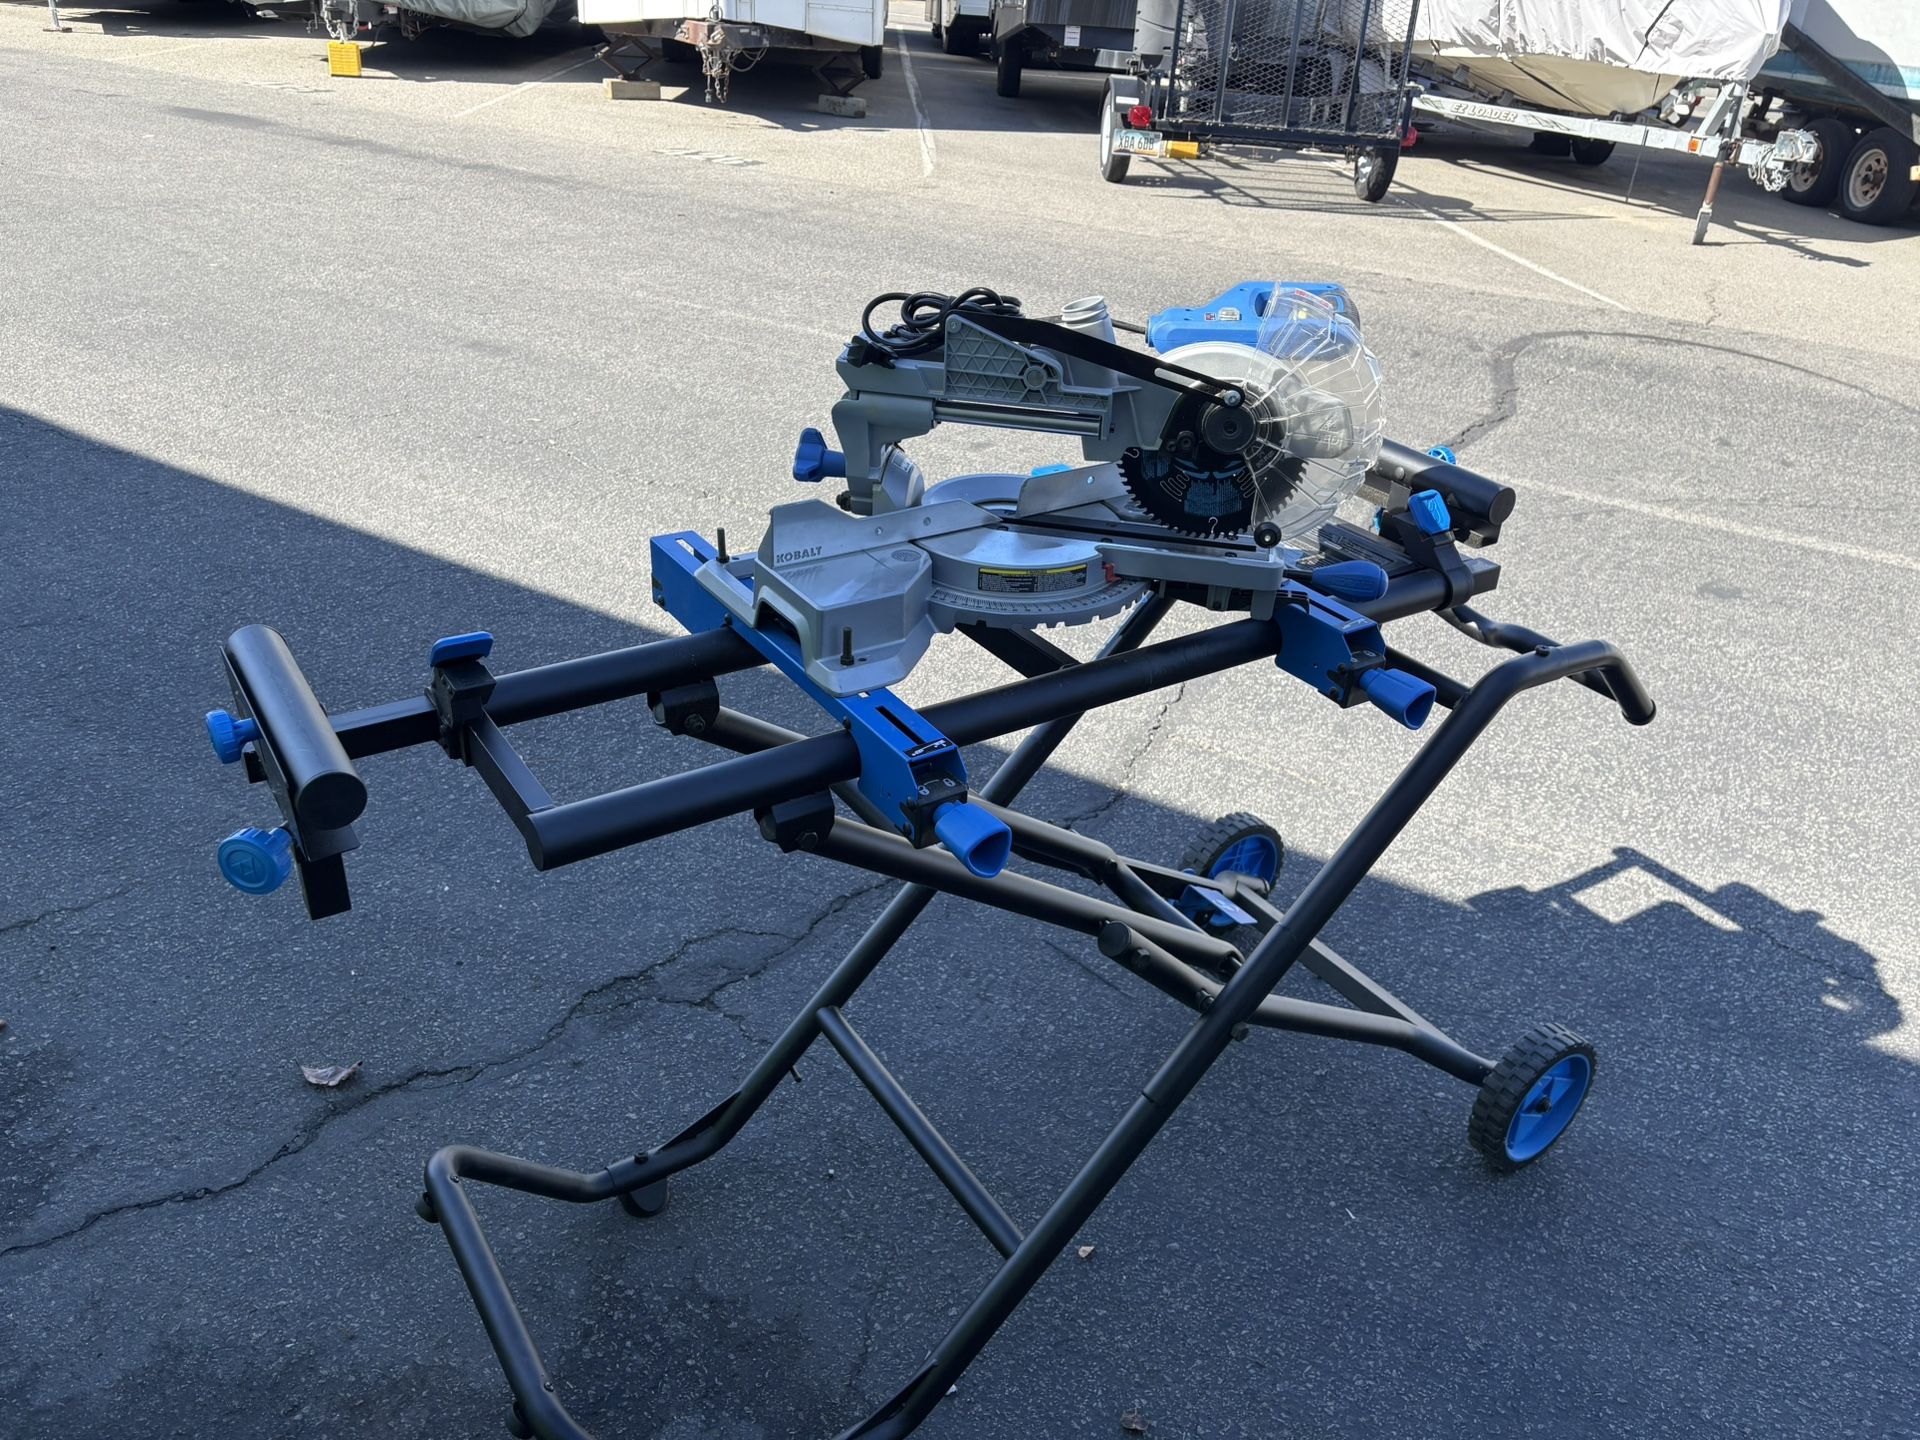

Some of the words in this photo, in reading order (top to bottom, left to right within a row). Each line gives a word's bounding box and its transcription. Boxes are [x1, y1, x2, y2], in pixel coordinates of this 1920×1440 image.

[1450, 103, 1469, 114] EZ
[1468, 105, 1518, 123] LOADER
[776, 546, 822, 564] KOBALT
